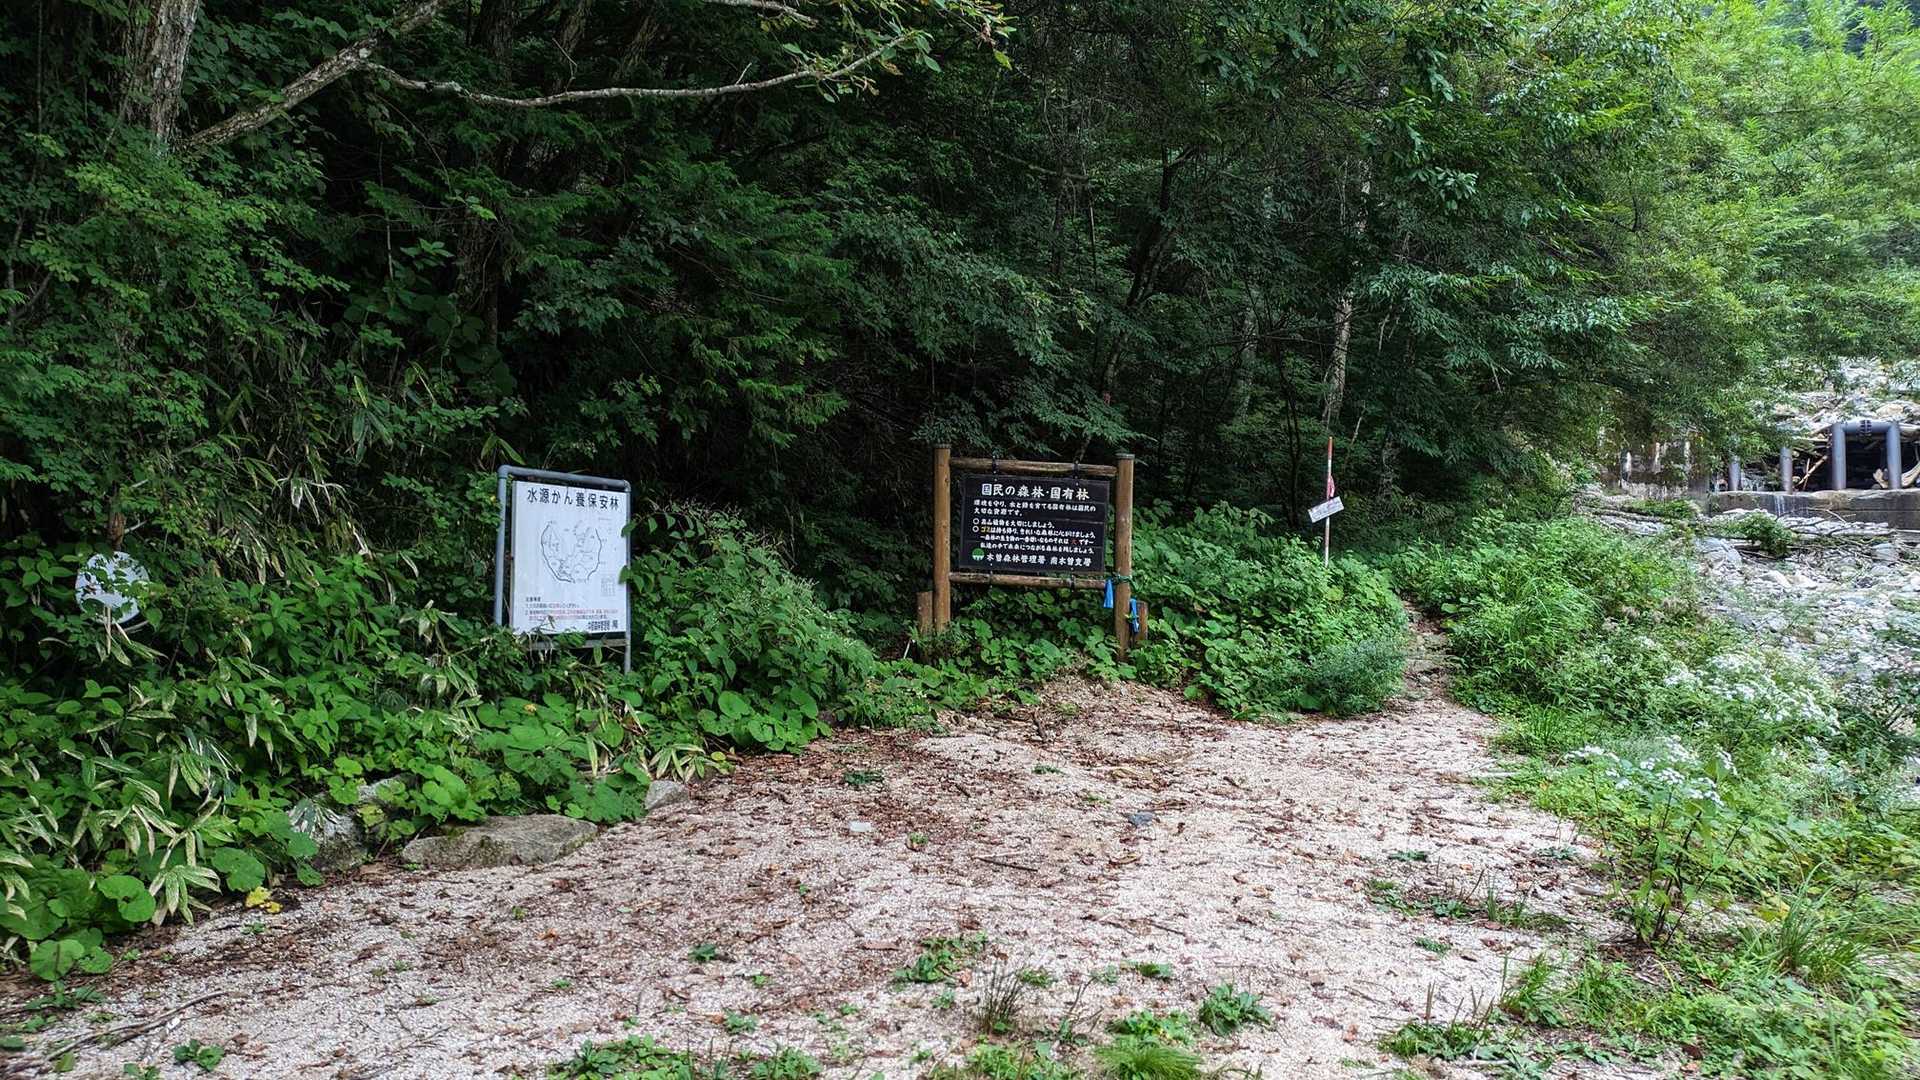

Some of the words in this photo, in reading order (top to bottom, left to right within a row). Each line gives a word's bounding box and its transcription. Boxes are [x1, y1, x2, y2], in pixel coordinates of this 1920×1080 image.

[527, 487, 619, 510] 水源かん養保安林
[982, 483, 1090, 500] 国民の森林・国有林
